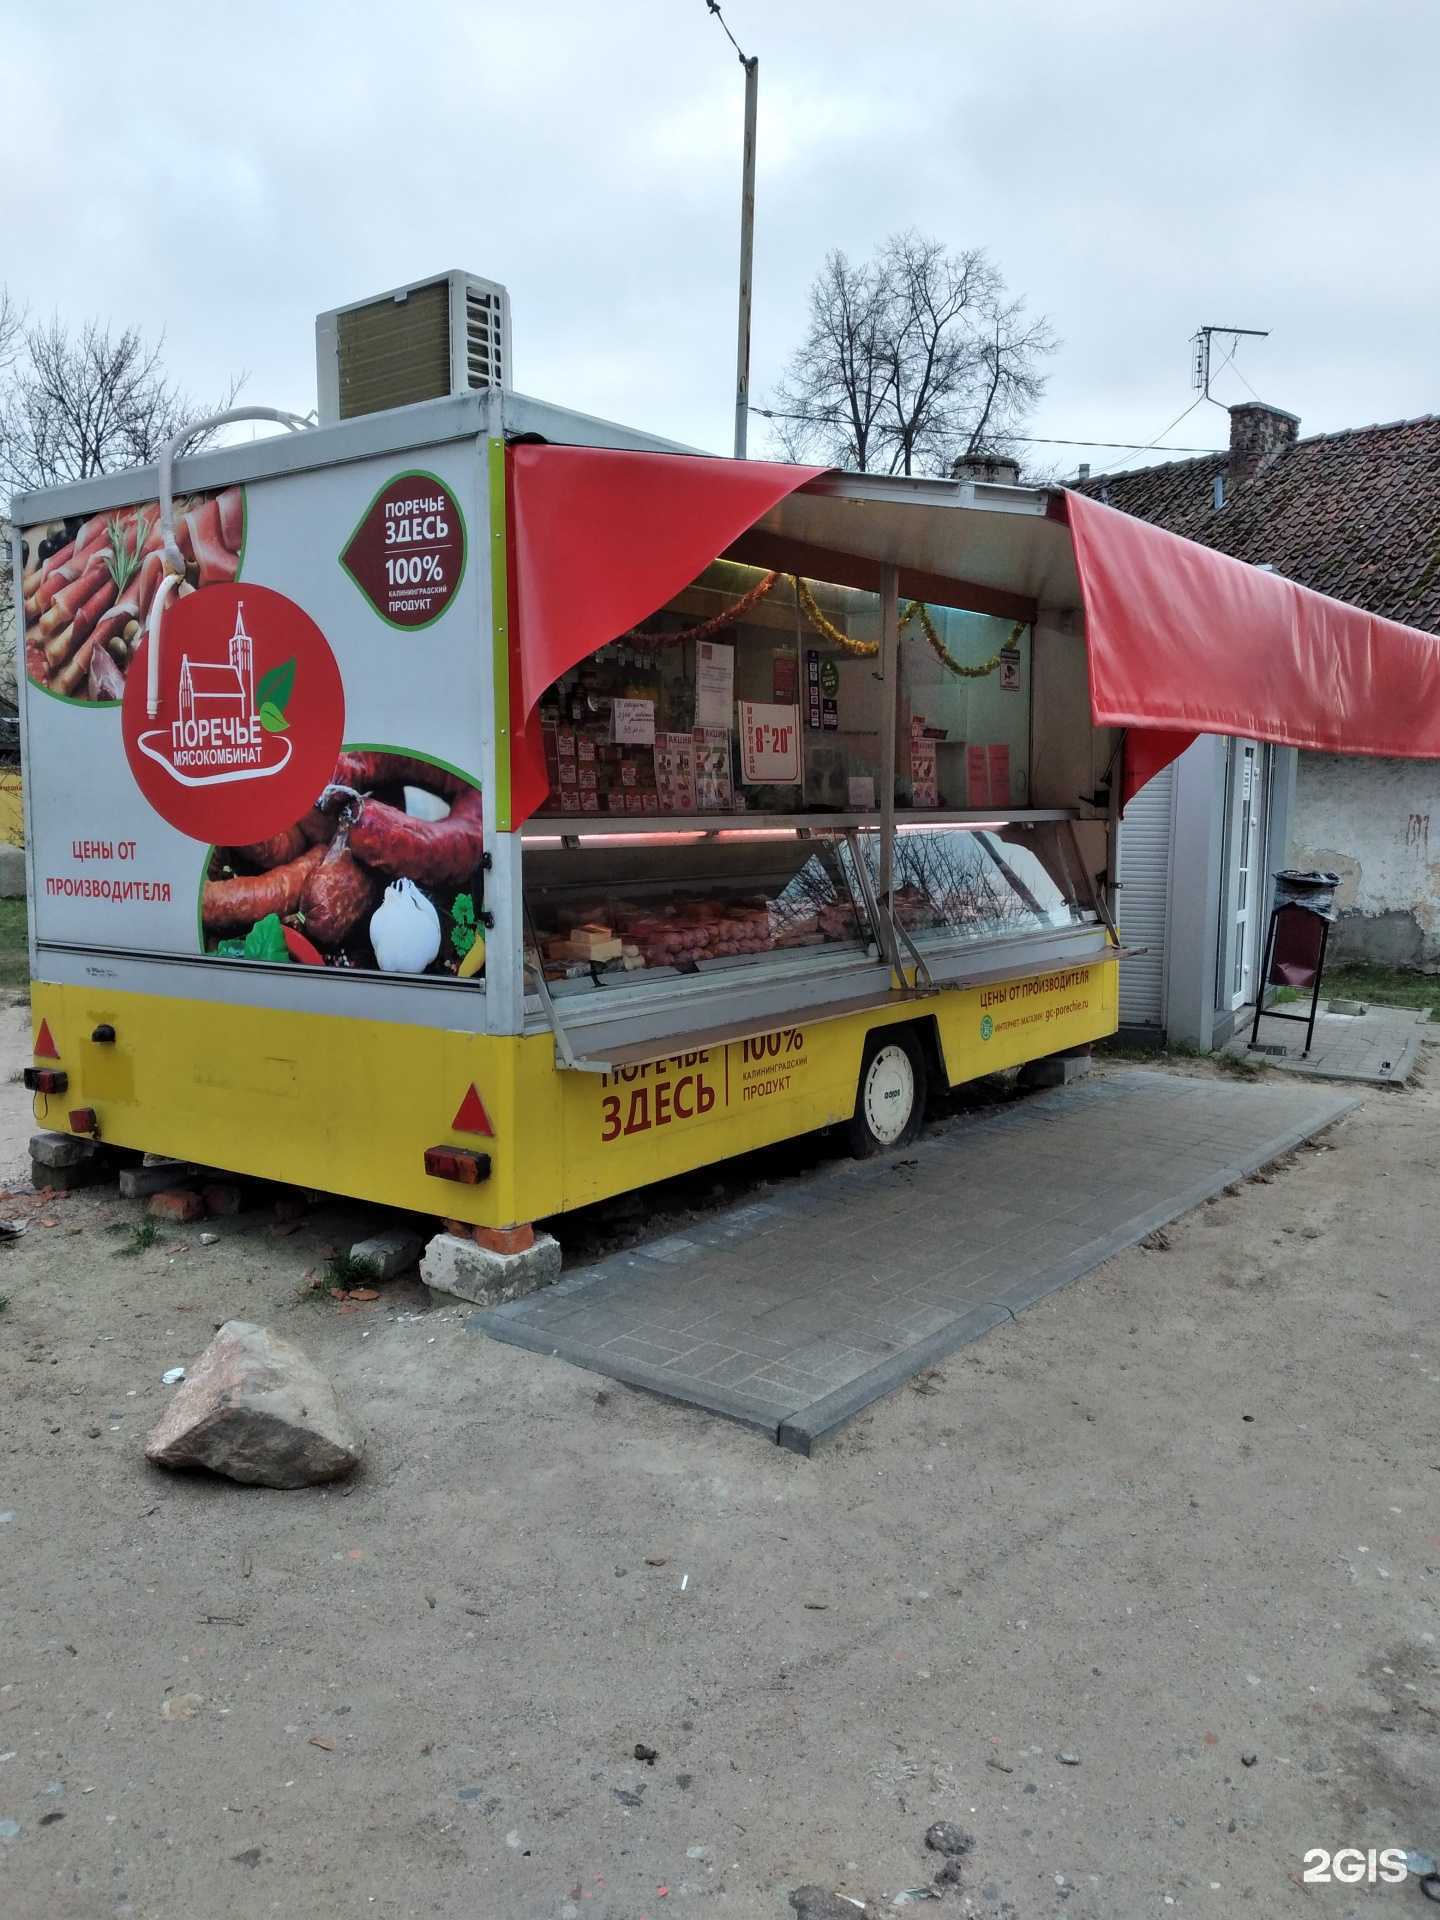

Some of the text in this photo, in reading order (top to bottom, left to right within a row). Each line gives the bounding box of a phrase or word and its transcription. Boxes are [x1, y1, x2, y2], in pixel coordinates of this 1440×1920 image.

[385, 495, 445, 518] ПОРЕЧЬЕ
[385, 515, 449, 544] ЗДЕСЬ
[385, 555, 443, 585] 100%
[388, 585, 447, 597] КАЛИНИНГРАДСКИЙ
[388, 598, 432, 612] ПРОДУКТ
[172, 715, 262, 748] ПОРЕЧЬЕ
[173, 746, 262, 766] МЯСОКОМБИНАТ
[72, 840, 137, 863] ЦЕНЫ ОТ
[46, 877, 171, 903] ПРОИЗВОДИТЕЛЯ
[980, 969, 1089, 1009] ЦЕНЫ ОТ ПРОИЗВОДИТЕЛЯ
[743, 1028, 803, 1063] 100%
[743, 1056, 808, 1081] КАЛИНИНГРАДСКИЙ
[743, 1075, 791, 1101] ПРОДУКТ
[601, 1073, 715, 1142] ЗДЕСЬ
